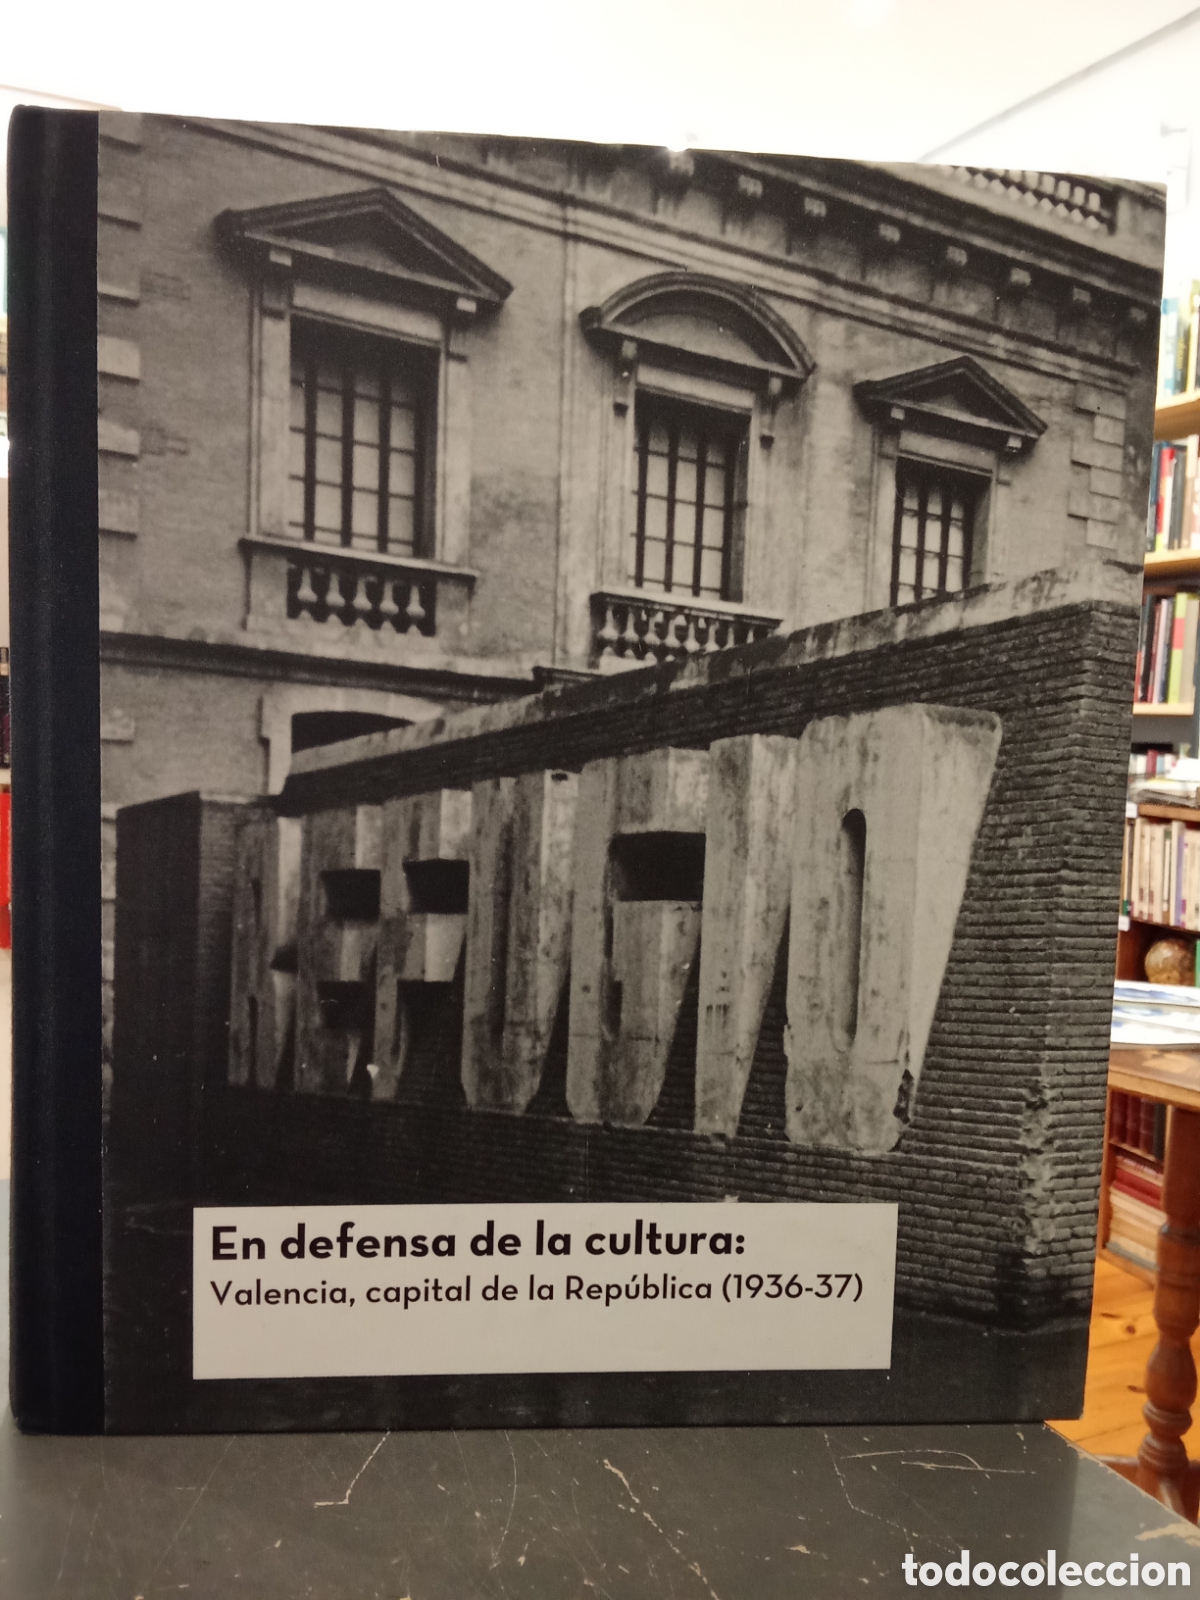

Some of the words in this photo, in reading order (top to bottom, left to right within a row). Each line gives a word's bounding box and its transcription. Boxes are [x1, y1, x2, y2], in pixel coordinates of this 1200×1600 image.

[213, 1226, 265, 1260] En
[281, 1222, 455, 1259] defensa
[471, 1220, 521, 1256] de
[536, 1220, 570, 1255] la
[586, 1219, 744, 1255] cultura:
[211, 1279, 354, 1307] Valencia,
[366, 1276, 470, 1309] capital
[482, 1275, 518, 1300] de
[530, 1275, 553, 1300] la
[566, 1274, 711, 1306] República
[723, 1273, 862, 1302] (1936-37)
